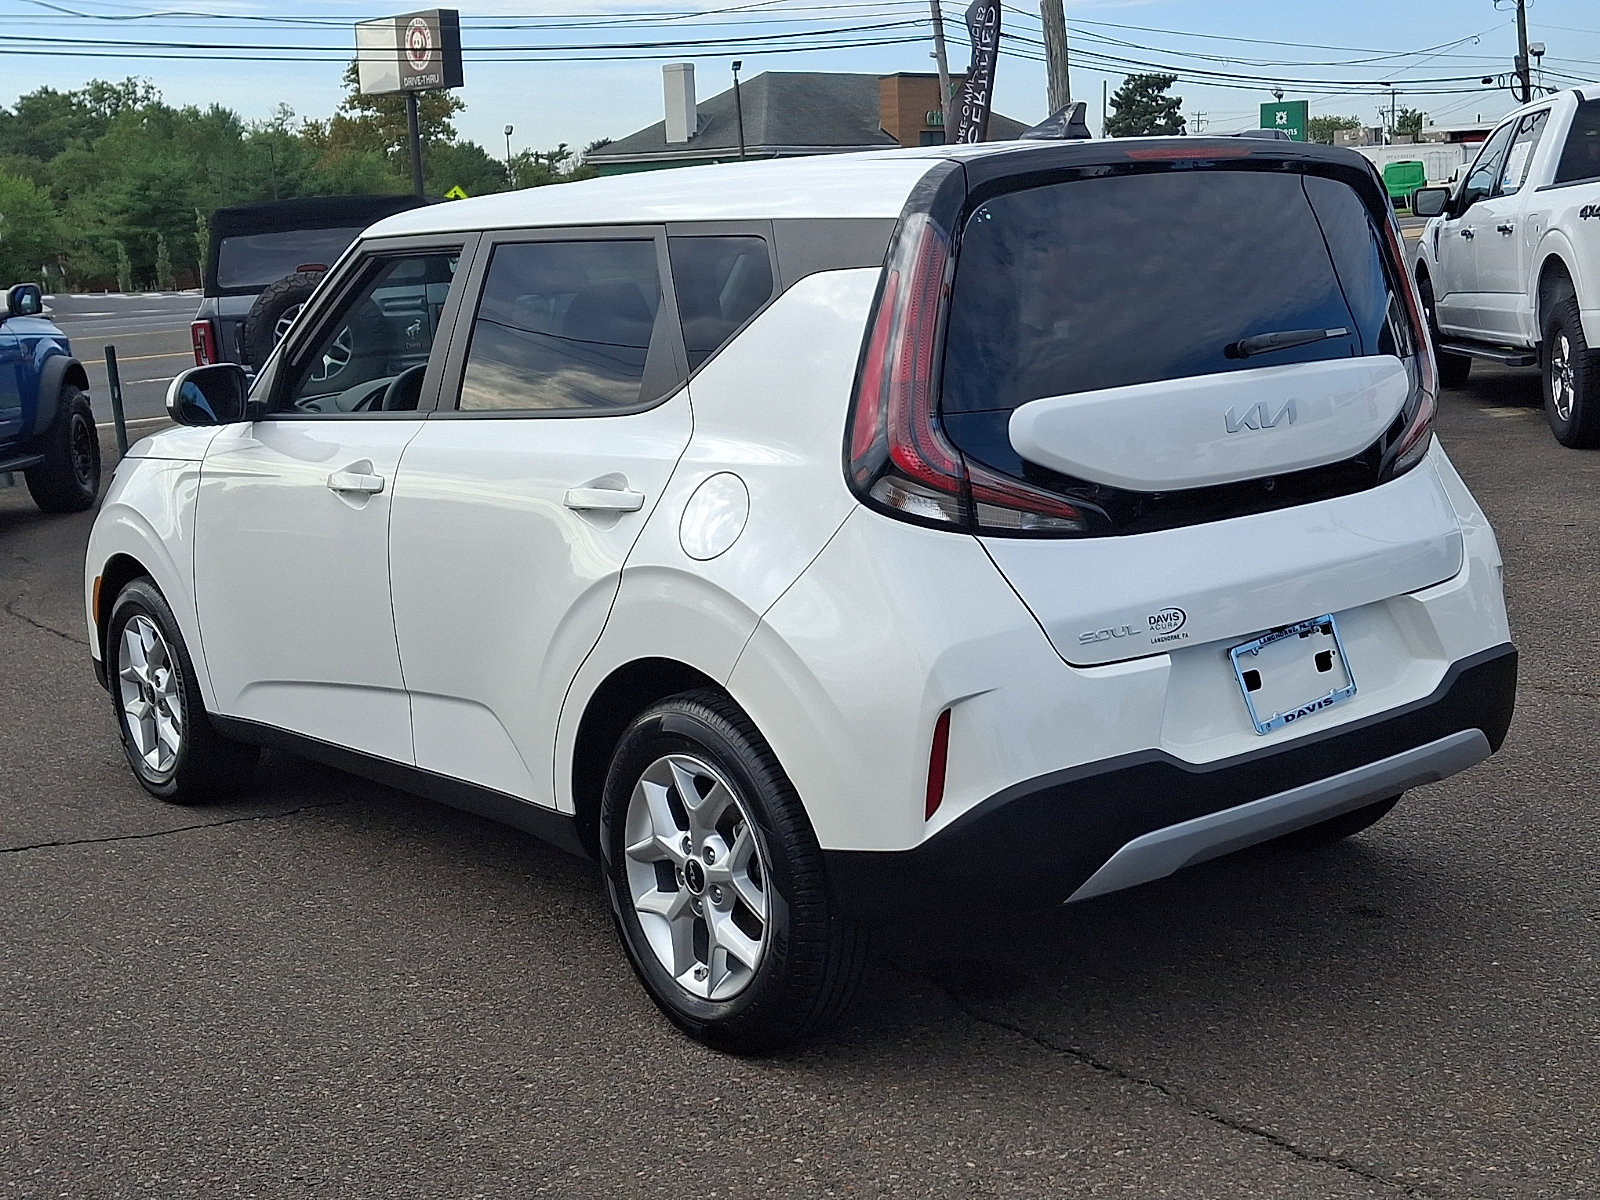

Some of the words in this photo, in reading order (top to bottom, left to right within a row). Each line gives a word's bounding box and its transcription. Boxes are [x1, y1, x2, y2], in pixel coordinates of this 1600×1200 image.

[403, 74, 440, 86] DRIVE-THRU
[1148, 612, 1180, 625] DAVIS
[1149, 622, 1179, 632] ACURA
[1079, 624, 1142, 645] SOUL
[1284, 697, 1334, 723] DAVIS
